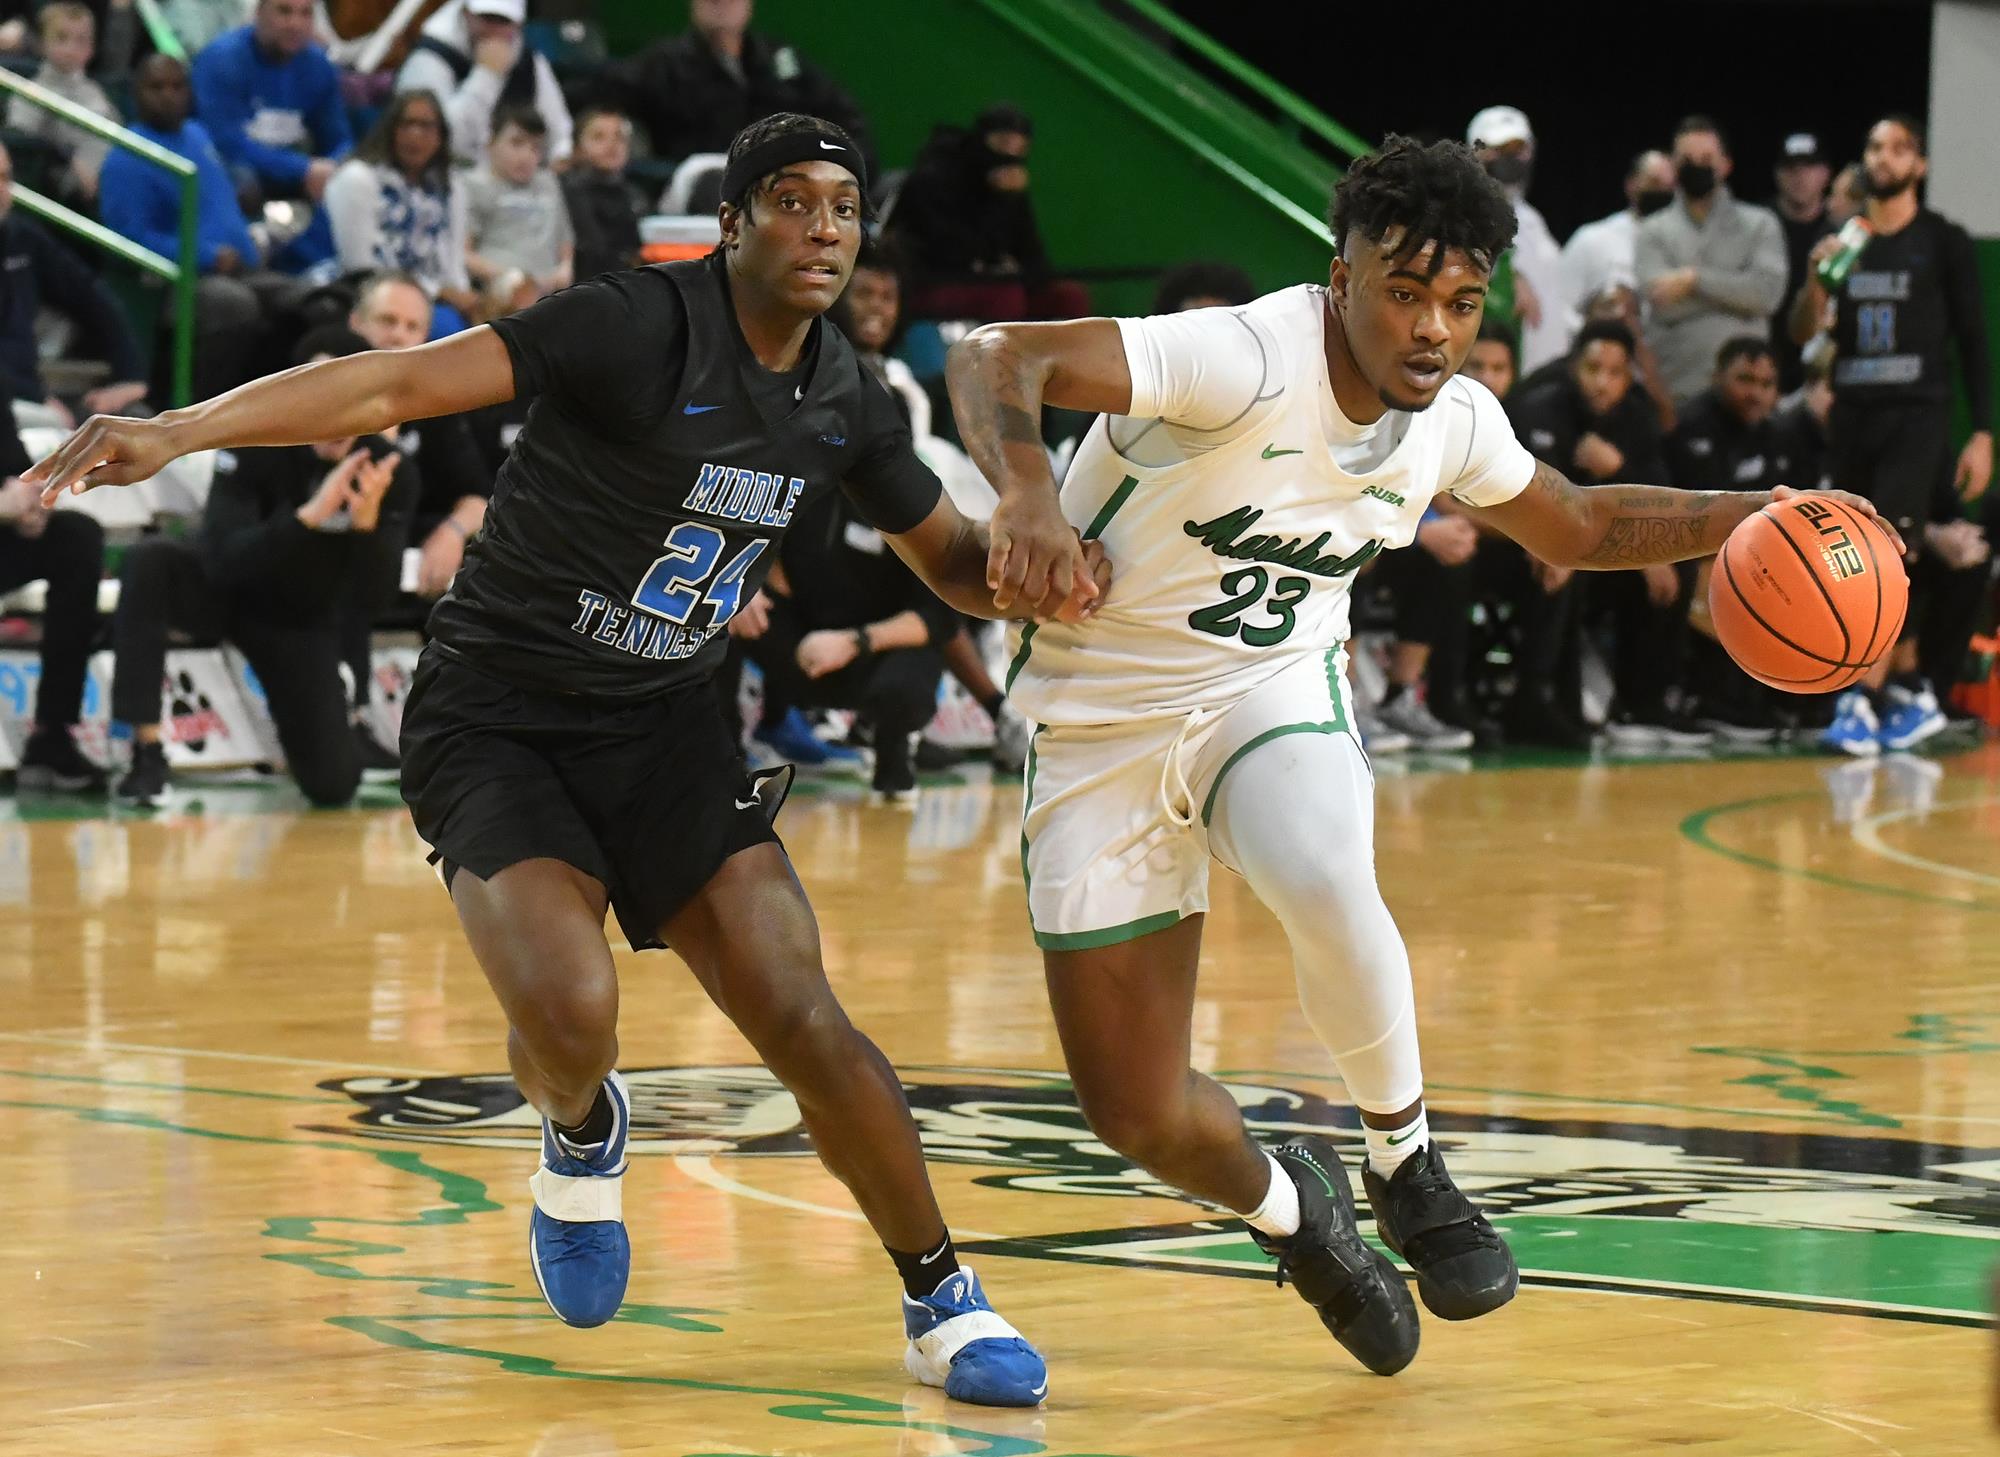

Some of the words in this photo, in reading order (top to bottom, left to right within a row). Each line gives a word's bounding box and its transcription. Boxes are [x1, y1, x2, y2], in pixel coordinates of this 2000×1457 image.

[682, 463, 805, 528] MIDDLE
[631, 521, 770, 628] 24
[1792, 500, 1865, 580] ELITE
[571, 589, 722, 660] TENNES
[1188, 566, 1311, 647] 23
